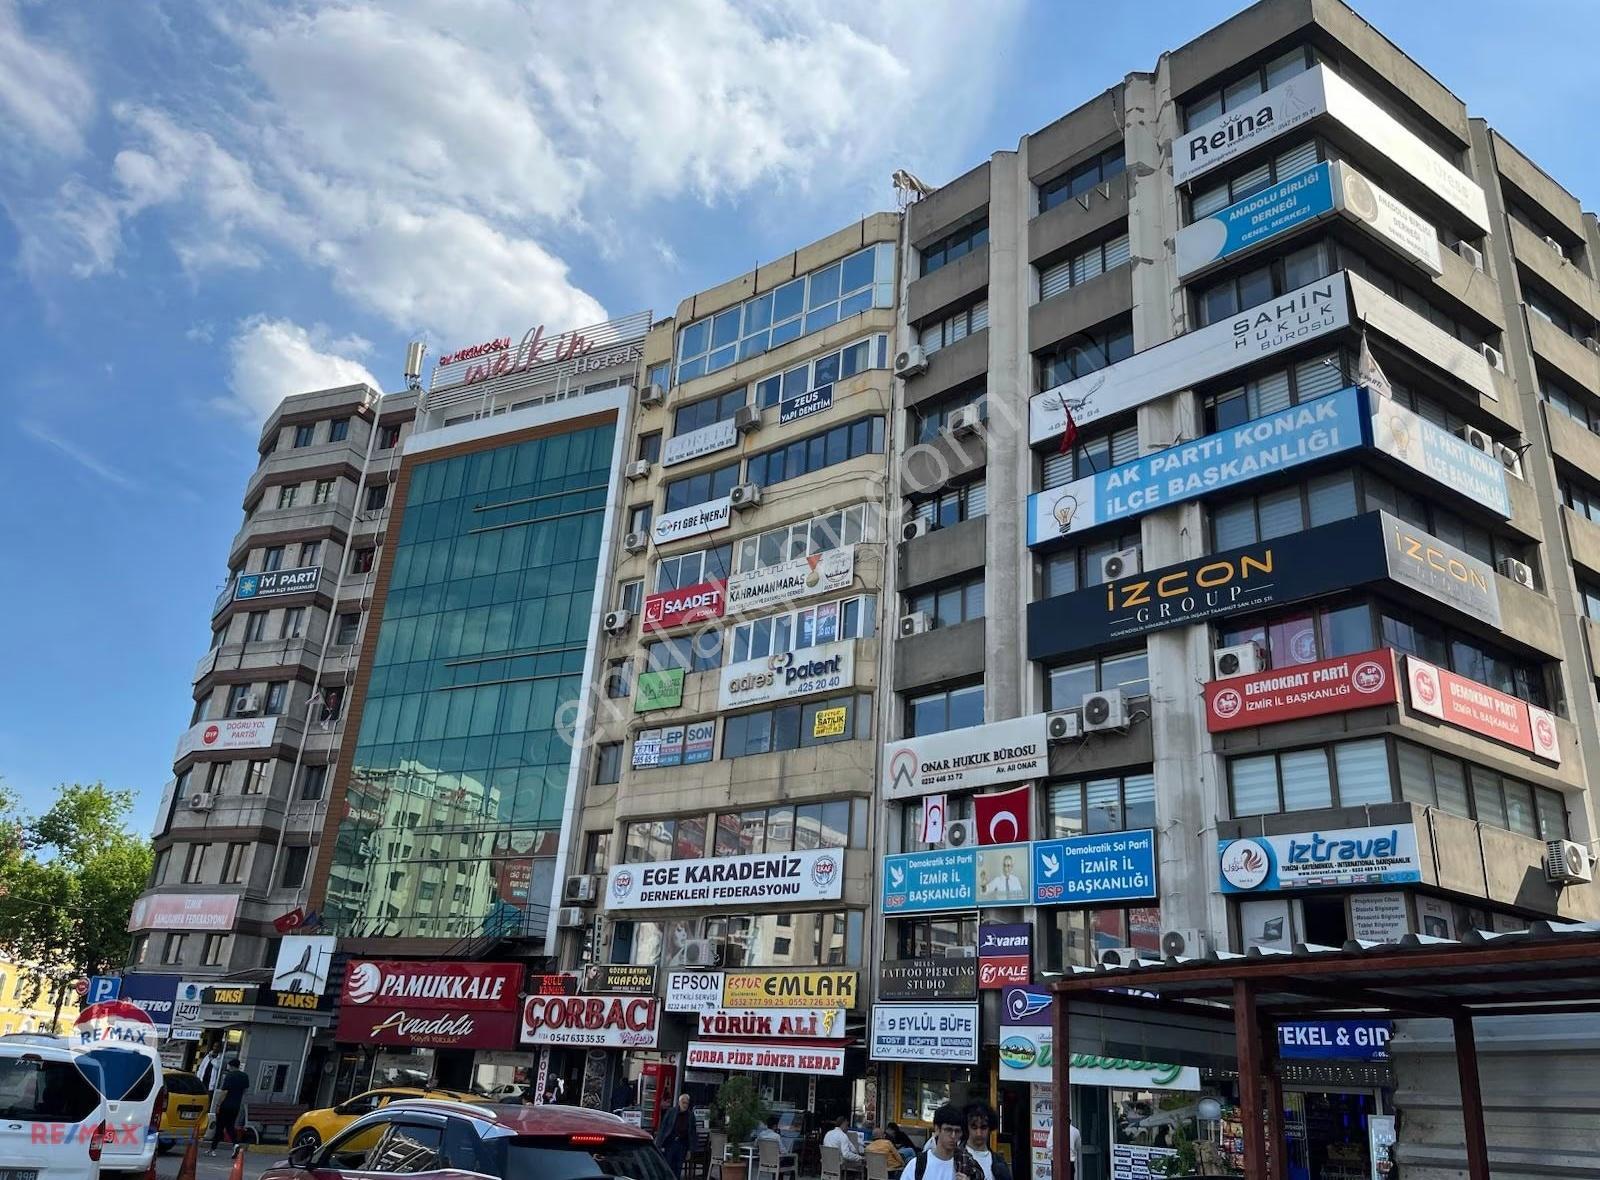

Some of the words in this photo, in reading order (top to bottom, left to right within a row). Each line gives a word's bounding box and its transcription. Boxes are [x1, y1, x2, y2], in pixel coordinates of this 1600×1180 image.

[1190, 107, 1273, 160] Reina
[1229, 192, 1277, 221] ANADOLU
[1280, 171, 1319, 198] BİRLİĞİ
[1251, 195, 1297, 225] DERNEĞİ
[1241, 225, 1269, 241] GENEL
[1271, 205, 1311, 228] MERKEZİ
[1233, 284, 1332, 338] ŞAHİN
[1235, 304, 1332, 349] HUKUK
[464, 324, 548, 386] walk
[794, 390, 818, 407] ZEUS
[781, 411, 797, 423] YAPI
[798, 399, 831, 417] DENETİM
[1106, 466, 1142, 491] AK
[1150, 438, 1223, 475] PARTİ
[1234, 399, 1338, 446] KONAK
[1107, 487, 1160, 515] İLÇE
[1168, 428, 1339, 497] BAŞKANLIĞI
[672, 521, 681, 532] F1
[683, 516, 698, 529] GBE
[700, 505, 728, 525] ENERJİ
[1395, 525, 1488, 594] İZCON
[260, 574, 277, 587] İYİ
[280, 569, 318, 585] PARTİ
[729, 575, 805, 602] KAHRAMANMARAŞ
[1107, 548, 1274, 612] İZCON
[664, 591, 720, 615] SAADET
[1137, 586, 1243, 623] GROUP
[785, 654, 841, 686] patent
[1245, 672, 1309, 696] DEMOKRAT
[1312, 662, 1349, 683] PARTİ
[729, 672, 774, 693] adres
[798, 680, 813, 693] 425
[815, 678, 827, 690] 20
[828, 676, 840, 687] 40
[1246, 697, 1272, 711] İZMİR
[1275, 694, 1284, 706] İL
[1286, 684, 1350, 703] BAŞKANLIĞI
[1449, 682, 1493, 710] DEMOKRAT
[1495, 699, 1518, 719] PARTİ
[226, 722, 250, 730] DOĞRU
[231, 729, 258, 738] PARTİSİ
[921, 758, 950, 773] ONAR
[953, 752, 991, 769] HUKUK
[994, 743, 1036, 761] BÜROSU
[1017, 760, 1038, 771] ONAR
[1065, 844, 1112, 856] Demokratik
[1113, 841, 1126, 852] Sol
[1128, 838, 1149, 850] Parti
[1288, 829, 1398, 863] iztravel
[642, 867, 679, 886] EGE
[685, 855, 802, 883] KARADENİZ
[909, 858, 944, 869] Demokratik
[944, 856, 955, 866] Sol
[956, 855, 973, 865] Parti
[1080, 857, 1119, 873] İZMİR
[1122, 855, 1134, 870] İL
[919, 869, 949, 884] İZMİR
[951, 867, 961, 882] İL
[1068, 870, 1149, 894] BAŞKANLIĞI
[640, 886, 710, 902] DERNEKLERİ
[712, 882, 801, 899] FEDERASYONU
[885, 895, 906, 907] DSP
[909, 883, 971, 902] BAŞKANLIĞI
[1038, 885, 1064, 899] DSP
[997, 936, 1029, 947] varan
[607, 975, 652, 986] KUAFÖRÜ
[671, 975, 720, 990] EPSON
[882, 968, 921, 978] TATTOO
[926, 966, 975, 977] PIERCING
[998, 966, 1028, 976] KALE
[94, 979, 113, 1002] P
[379, 974, 506, 1000] PAMUKKALE
[764, 975, 852, 997] EMLAK
[907, 980, 946, 989] STUDIO
[370, 1010, 475, 1038] Anadolu
[525, 997, 656, 1036] ÇORBACI
[701, 1010, 772, 1035] YÖRÜK
[778, 1011, 818, 1036] ALİ
[888, 1019, 896, 1030] 9
[899, 1012, 936, 1031] EYLÜL
[939, 1014, 972, 1031] BÜFE
[911, 1037, 937, 1045] KÖFTE
[1336, 1026, 1350, 1046] &
[689, 1049, 724, 1065] ÇORBA
[727, 1048, 753, 1066] PİDE
[755, 1050, 795, 1068] DÖNER
[798, 1054, 841, 1071] KEBAP
[876, 1047, 891, 1055] ÇAY
[930, 1048, 973, 1057] ÇEŞİTLERİ
